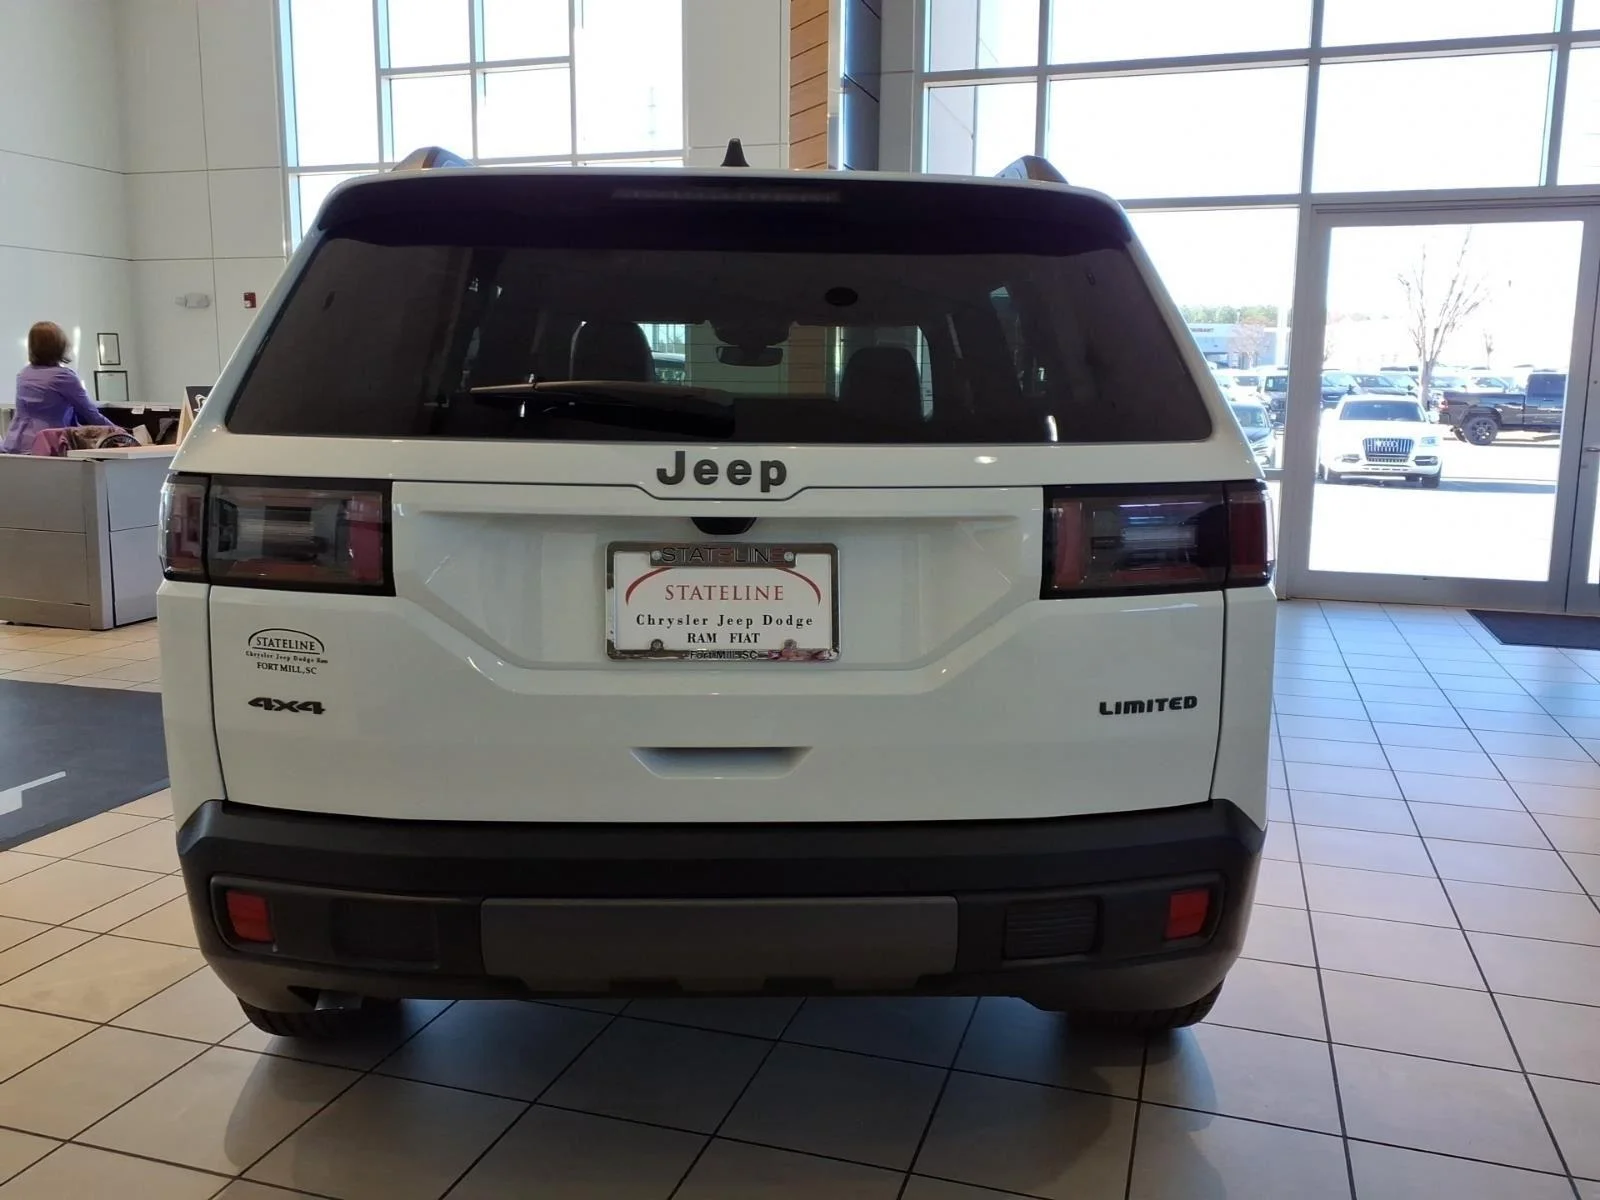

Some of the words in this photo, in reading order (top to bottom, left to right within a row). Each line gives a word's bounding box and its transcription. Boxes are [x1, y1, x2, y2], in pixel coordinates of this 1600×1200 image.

[656, 450, 787, 493] Jeep
[661, 546, 785, 564] STATELINE
[664, 584, 784, 601] STATELINE
[636, 614, 709, 629] Chrysler
[717, 614, 754, 629] Jeep
[763, 614, 813, 629] Dodge
[256, 637, 315, 651] STATELINE
[687, 632, 717, 644] RAM
[730, 632, 760, 644] FIAT
[245, 650, 274, 659] Chrysler
[256, 662, 279, 671] FORT
[1099, 695, 1198, 715] LIMITED
